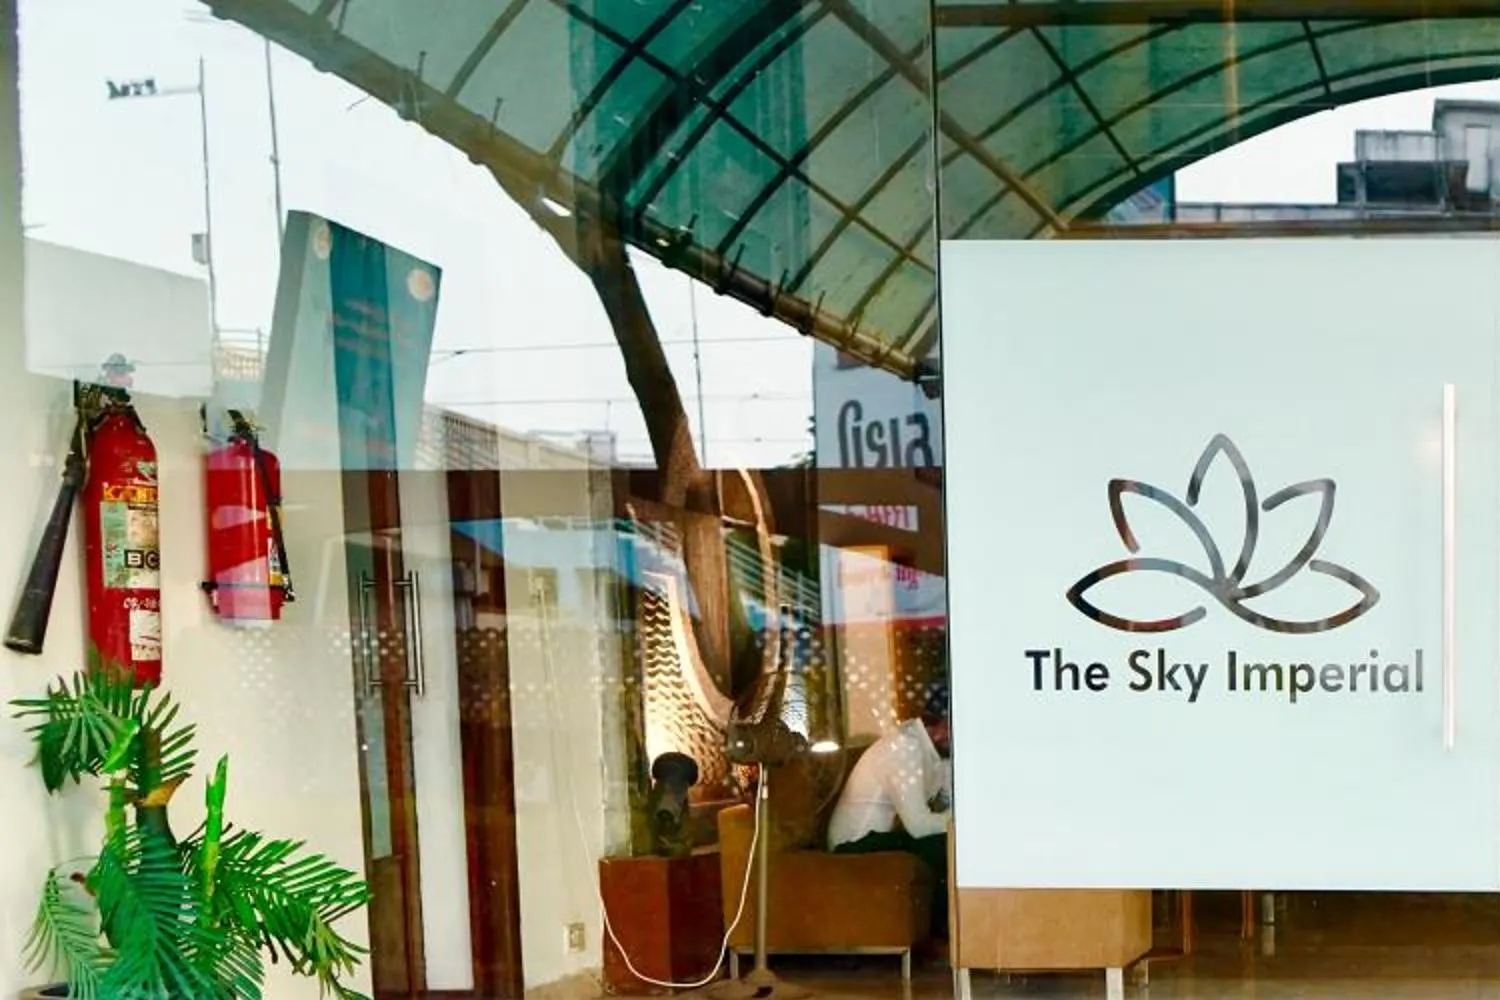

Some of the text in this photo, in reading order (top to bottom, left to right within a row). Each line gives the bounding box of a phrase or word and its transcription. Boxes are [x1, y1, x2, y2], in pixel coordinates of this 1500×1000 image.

[1024, 648, 1423, 704] The Sky Imperial
